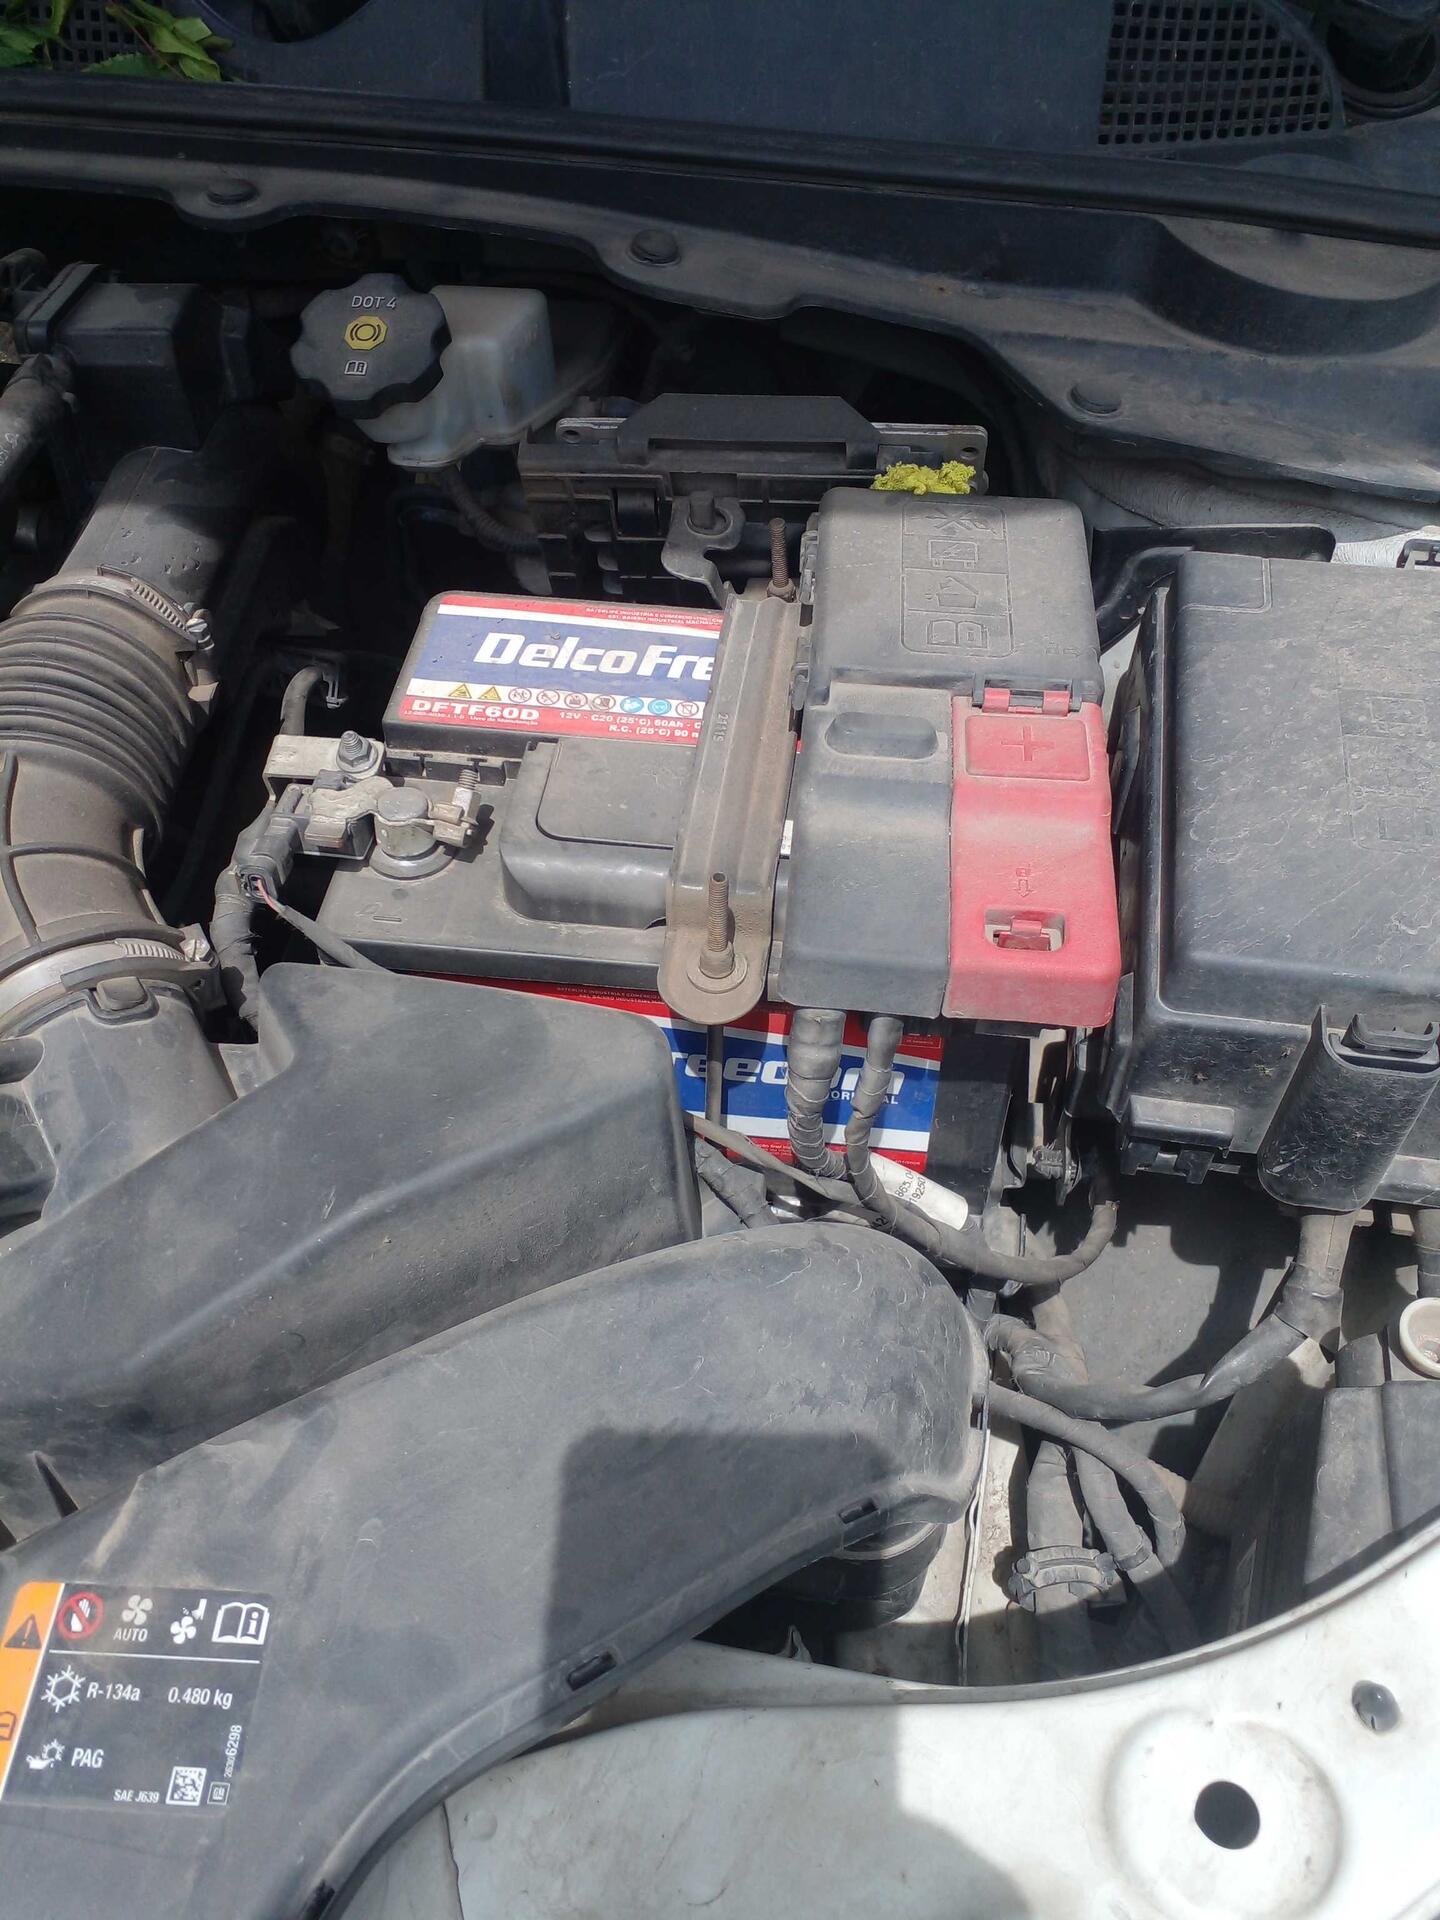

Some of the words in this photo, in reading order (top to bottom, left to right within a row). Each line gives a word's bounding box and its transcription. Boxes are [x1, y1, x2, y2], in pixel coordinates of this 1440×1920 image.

[351, 295, 385, 308] DOT
[386, 296, 397, 309] 4
[411, 699, 540, 721] DFTF60D
[560, 711, 581, 720] 12V
[591, 714, 613, 722] C20
[654, 719, 684, 728] 60Ah
[608, 724, 633, 733] R.C.
[674, 729, 689, 737] 90
[112, 1627, 149, 1643] AUTO
[86, 1682, 141, 1702] R-134a
[167, 1686, 211, 1705] 0.480
[213, 1689, 234, 1710] kg
[71, 1748, 105, 1769] PAG
[113, 1788, 133, 1802] SAE
[134, 1790, 160, 1804] J639
